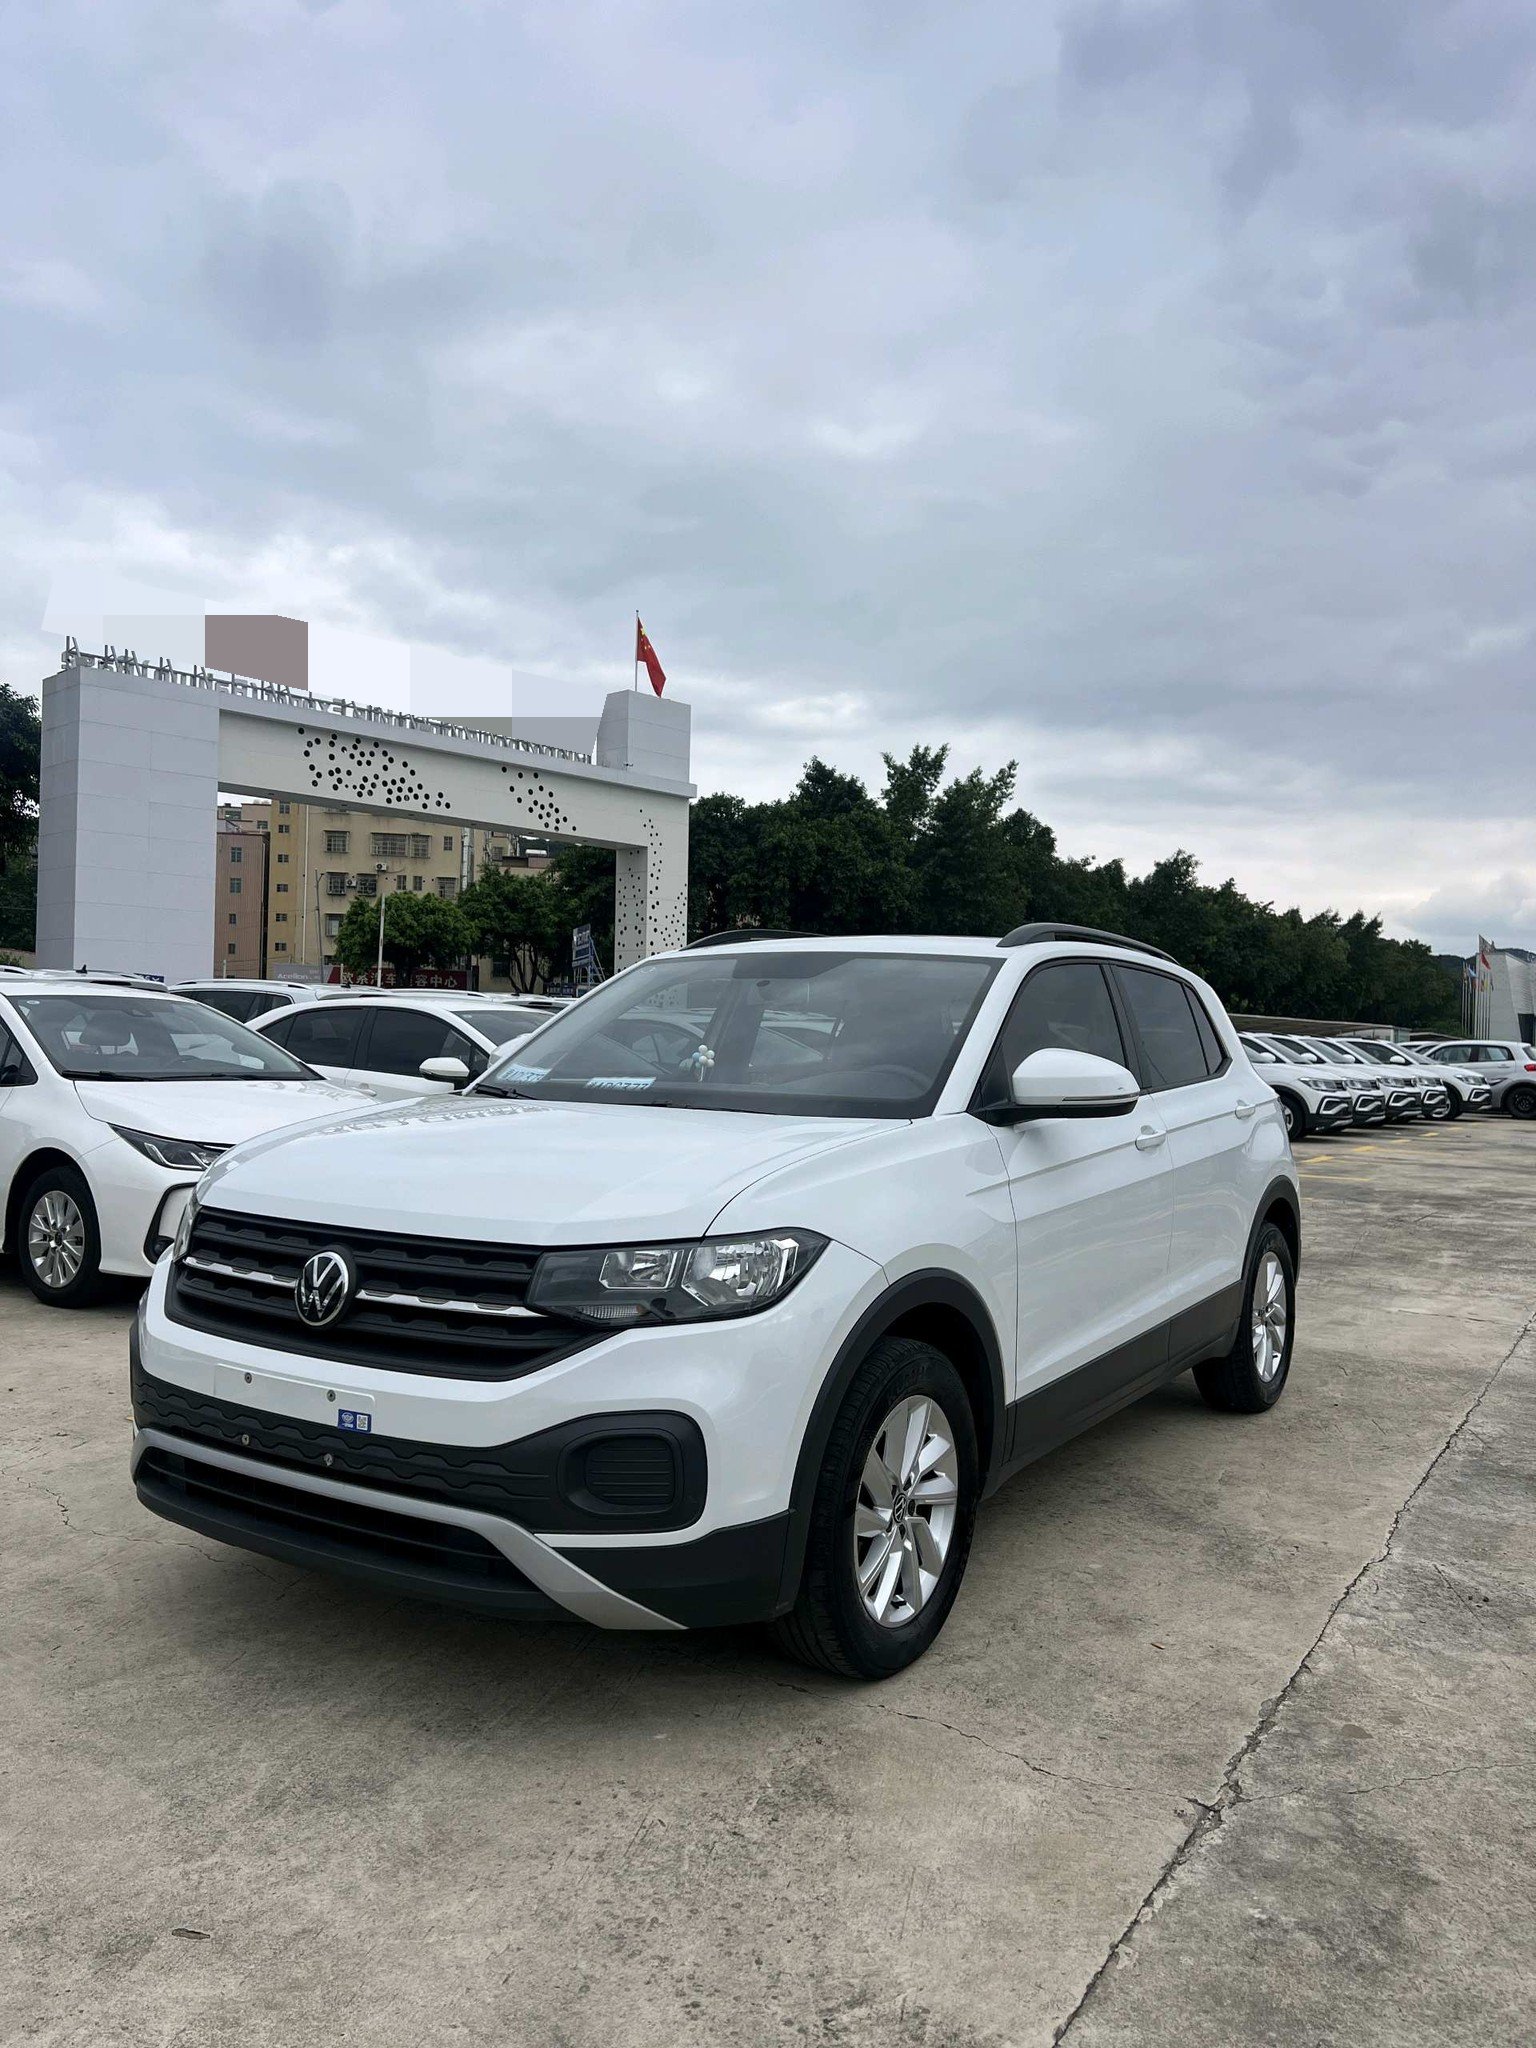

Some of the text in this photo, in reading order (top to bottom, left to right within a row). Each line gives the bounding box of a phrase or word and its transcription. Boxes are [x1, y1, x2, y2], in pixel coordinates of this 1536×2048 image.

[342, 972, 458, 988] 欧系汽车容中心
